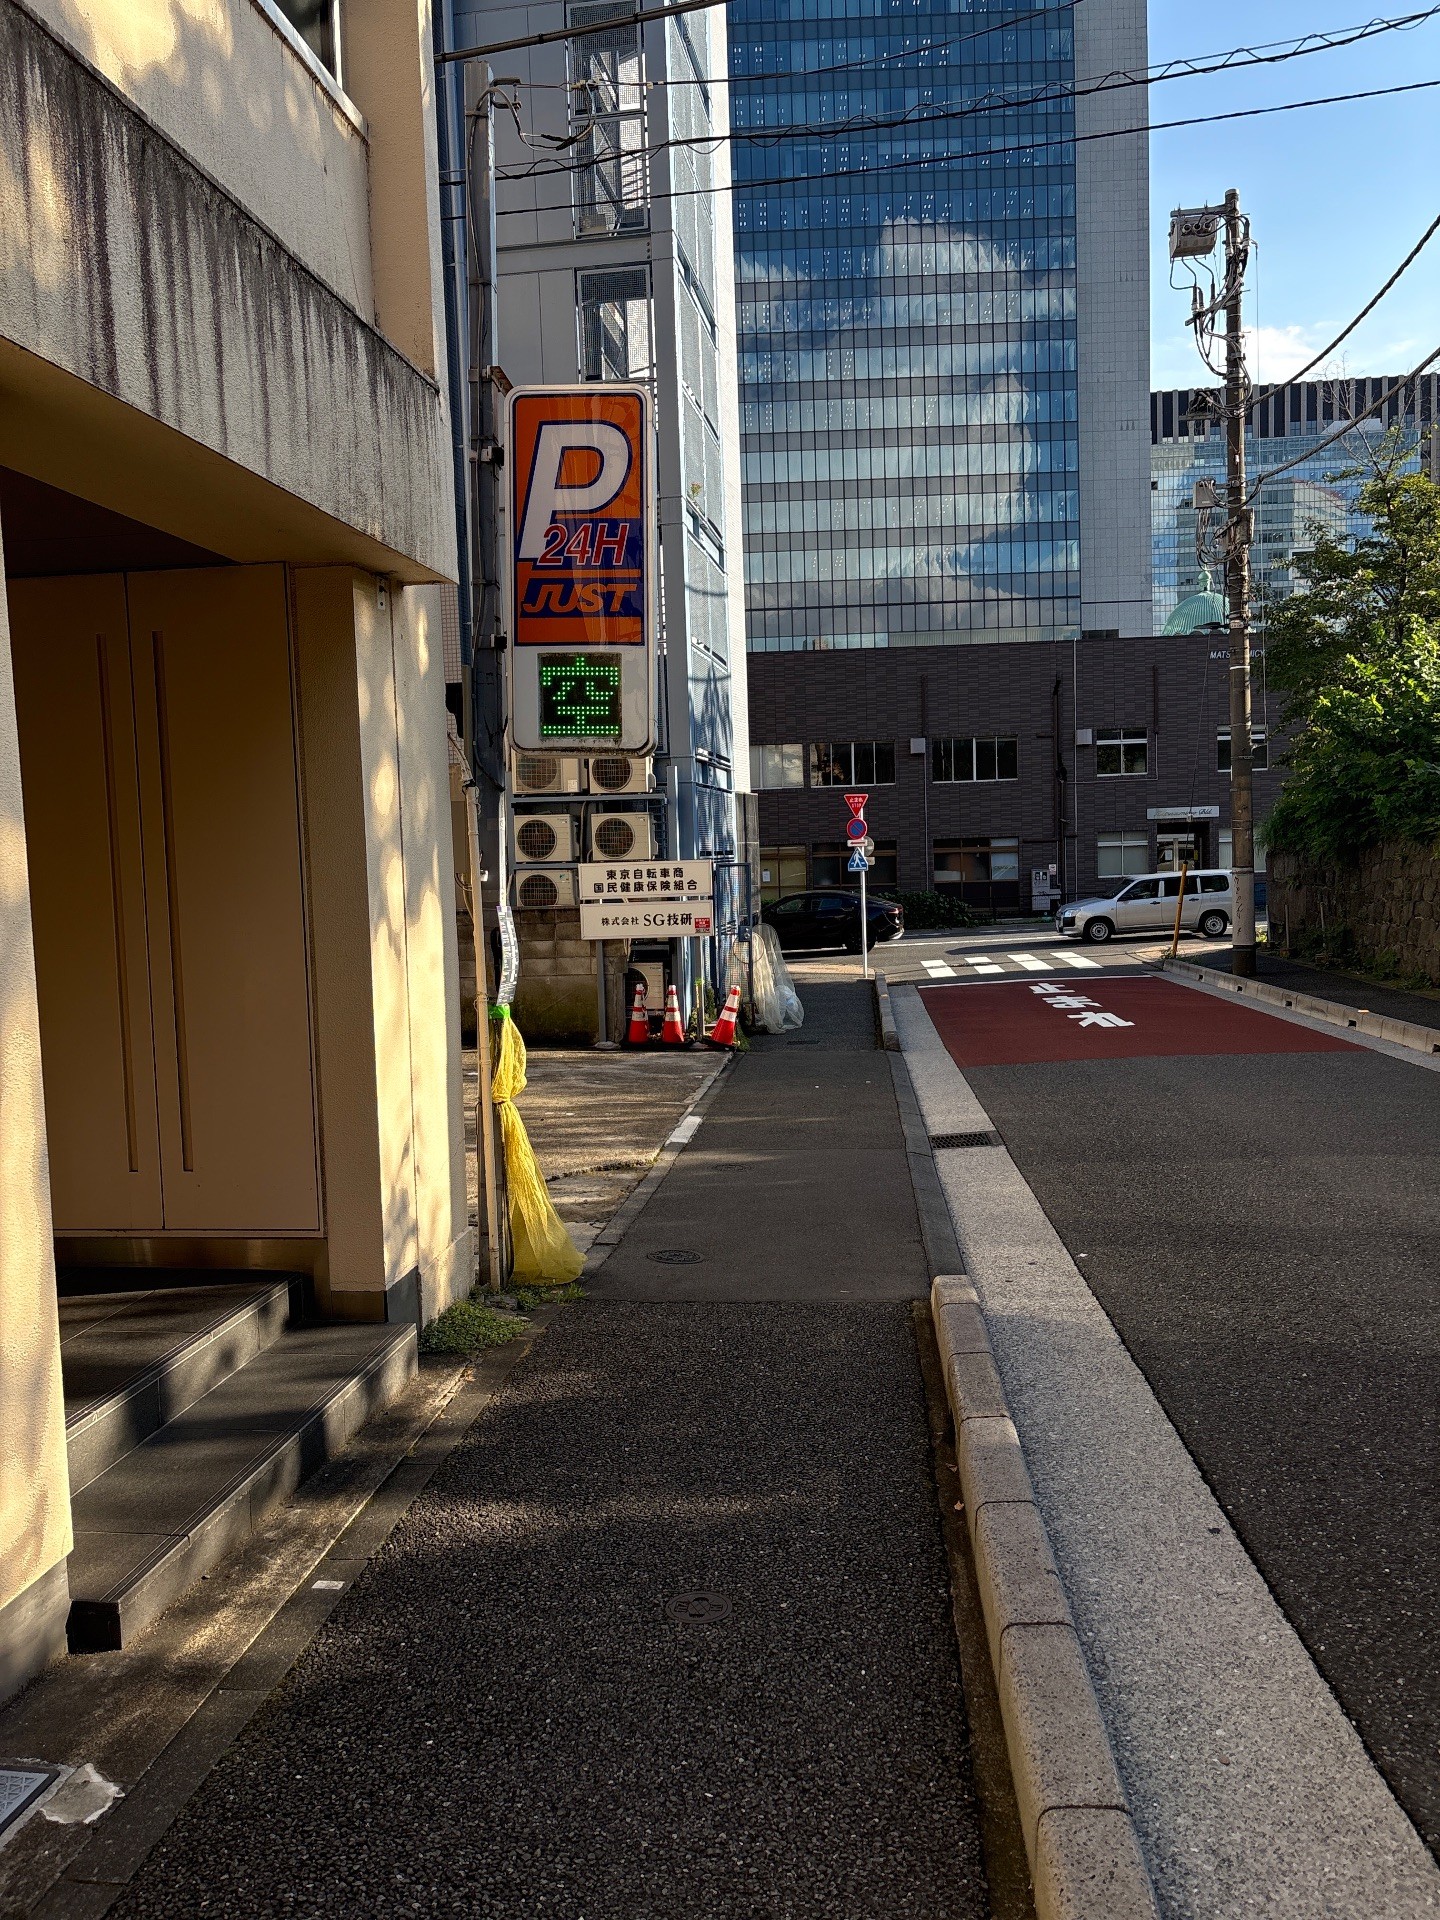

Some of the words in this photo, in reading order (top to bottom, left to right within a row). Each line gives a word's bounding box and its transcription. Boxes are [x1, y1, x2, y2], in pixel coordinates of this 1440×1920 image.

[519, 421, 632, 559] P
[538, 523, 629, 566] 24H
[523, 584, 639, 613] JUST
[541, 657, 620, 735] 空
[593, 879, 698, 893] 国民健康保険組合
[606, 867, 684, 880] 東京自転車商
[1028, 982, 1136, 1028] 止まれ
